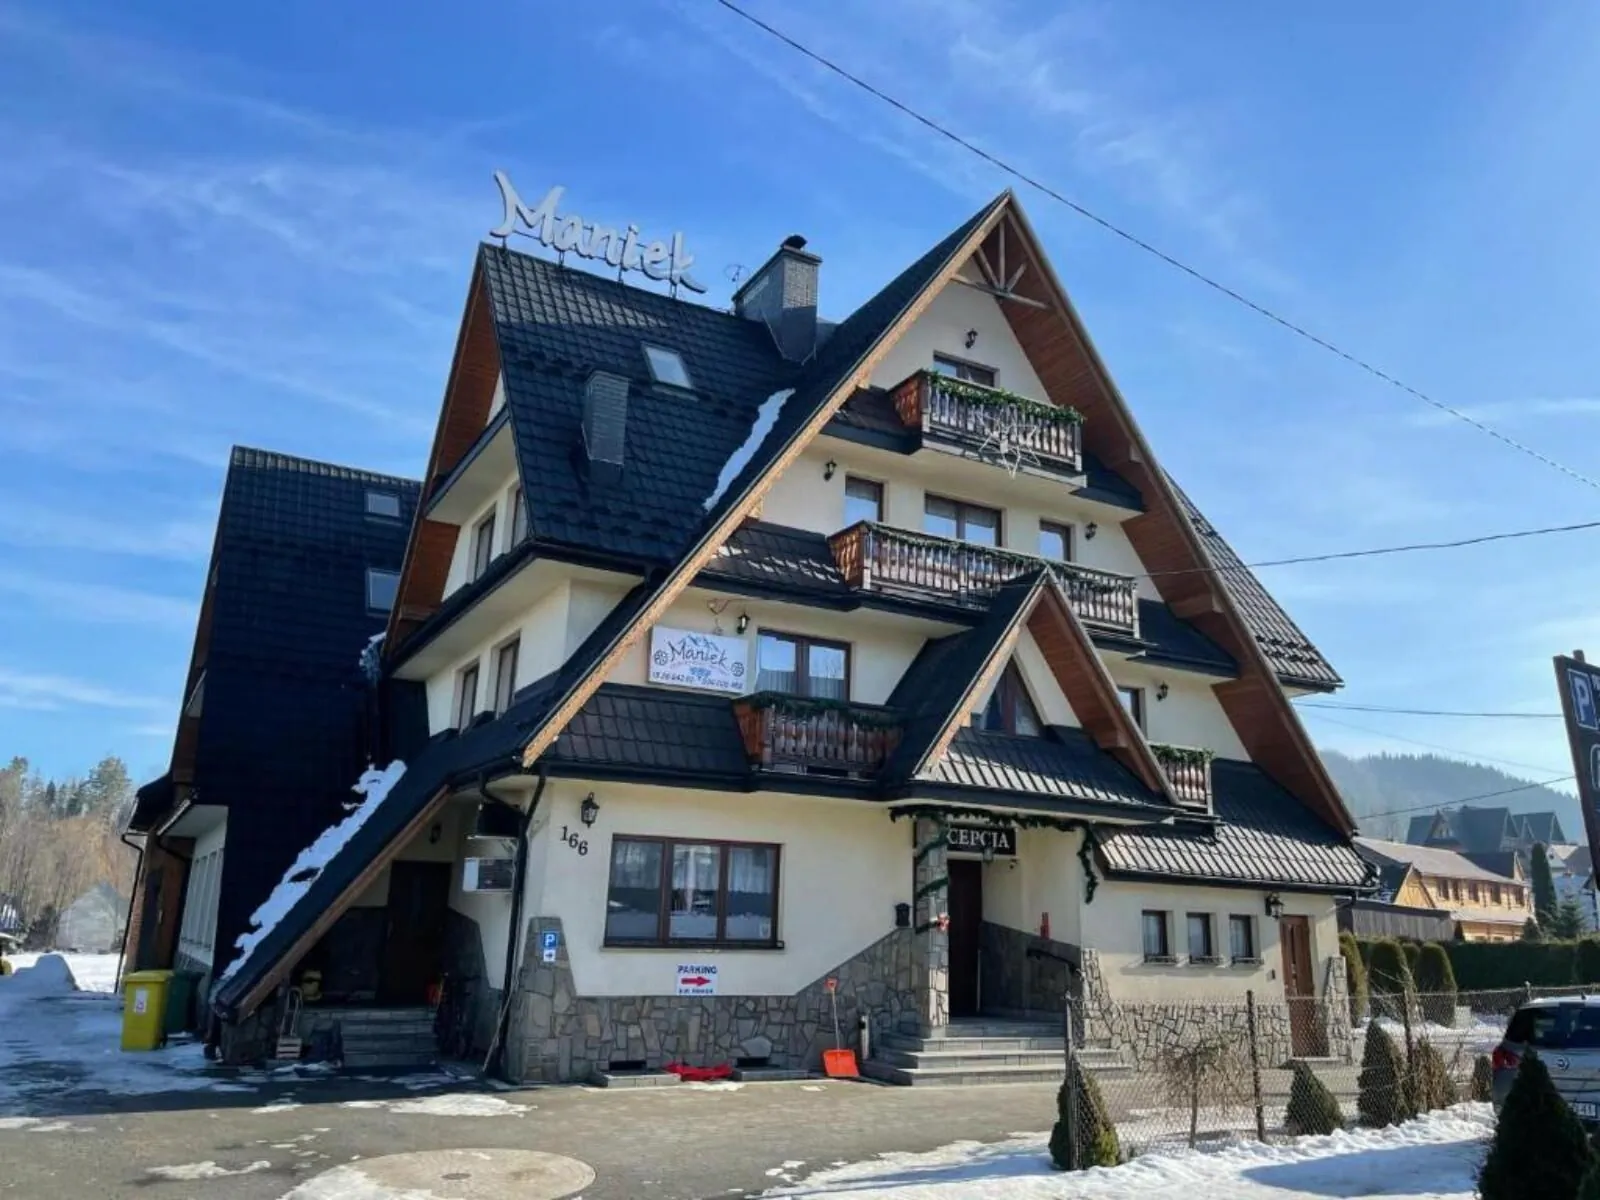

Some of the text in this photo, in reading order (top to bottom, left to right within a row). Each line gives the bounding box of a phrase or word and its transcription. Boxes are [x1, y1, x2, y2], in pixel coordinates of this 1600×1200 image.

[490, 169, 707, 294] Maniek
[665, 638, 730, 671] Maniek
[1574, 677, 1589, 721] P
[560, 825, 589, 856] 166
[946, 828, 1010, 849] CEPCJA
[545, 934, 555, 946] P
[677, 964, 717, 974] PARKING
